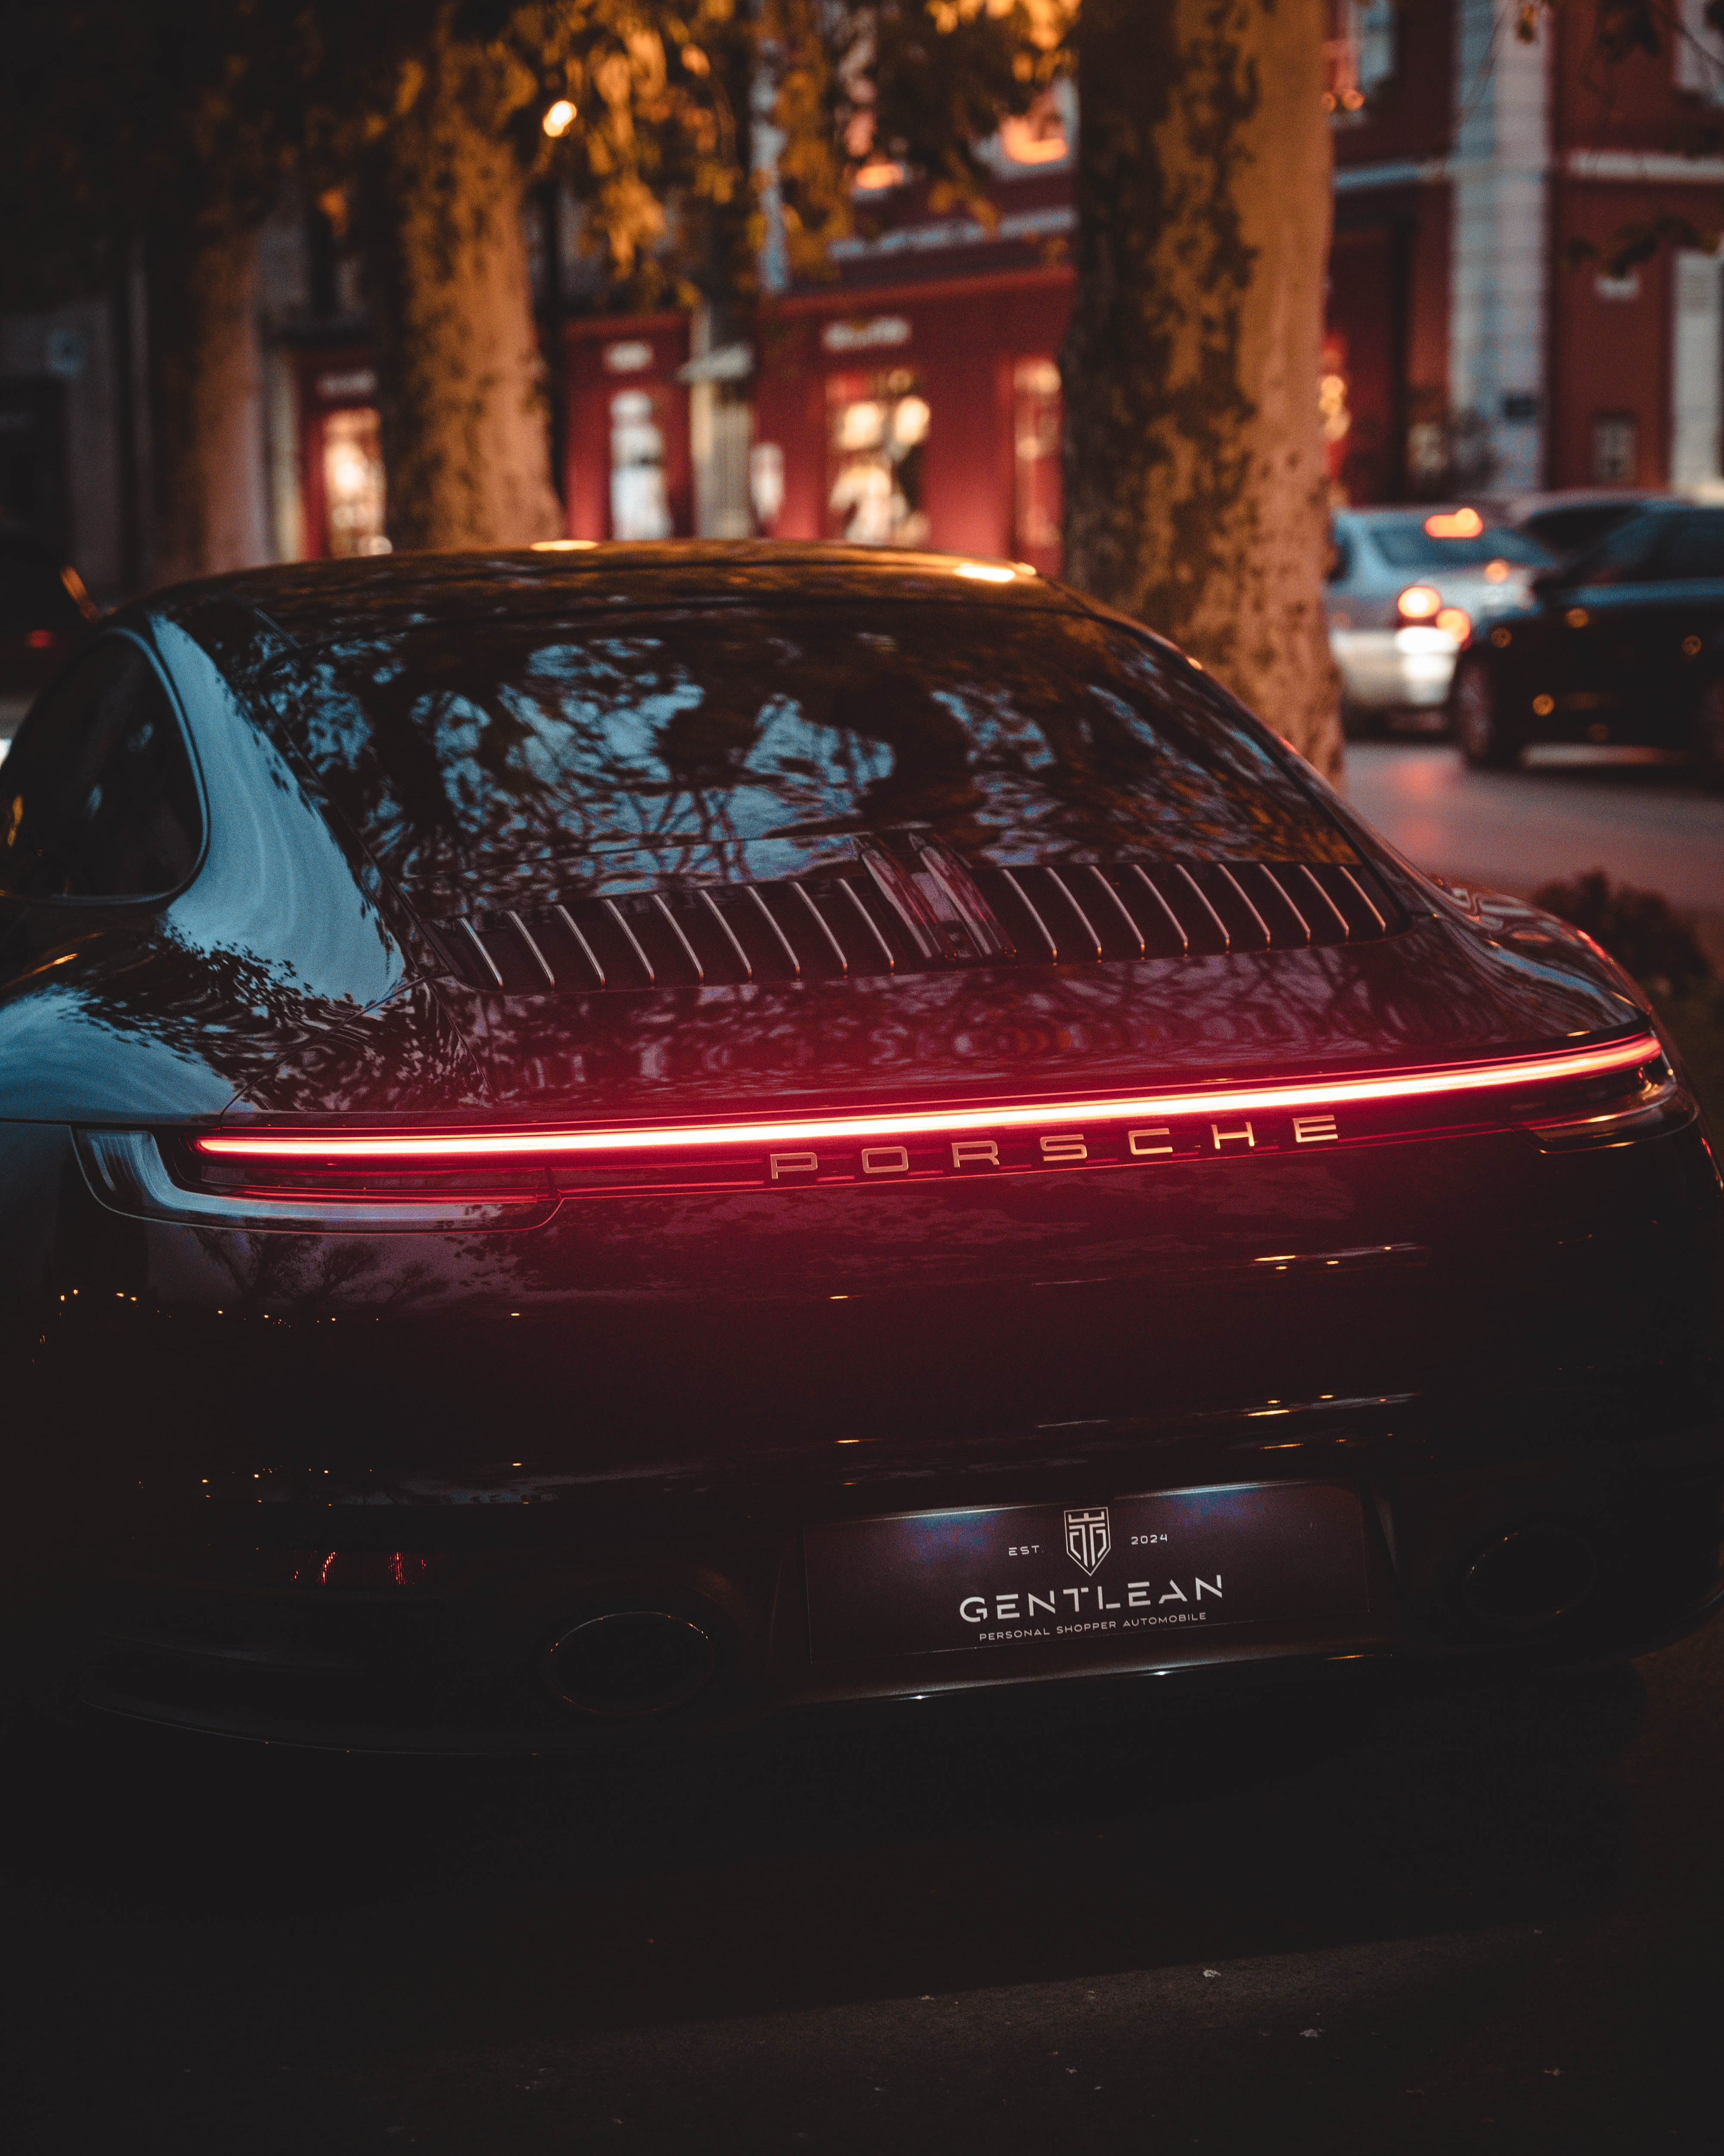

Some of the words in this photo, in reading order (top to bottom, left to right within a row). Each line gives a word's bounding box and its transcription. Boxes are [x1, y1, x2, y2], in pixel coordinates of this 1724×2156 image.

[770, 1114, 1339, 1180] PORSCHE
[1131, 1533, 1168, 1545] 2024
[959, 1574, 1223, 1623] GENTLEAN
[979, 1628, 1050, 1641] PERSONAL
[1056, 1621, 1117, 1634] SHOPPER
[1122, 1612, 1207, 1628] AUTOMOBILE
